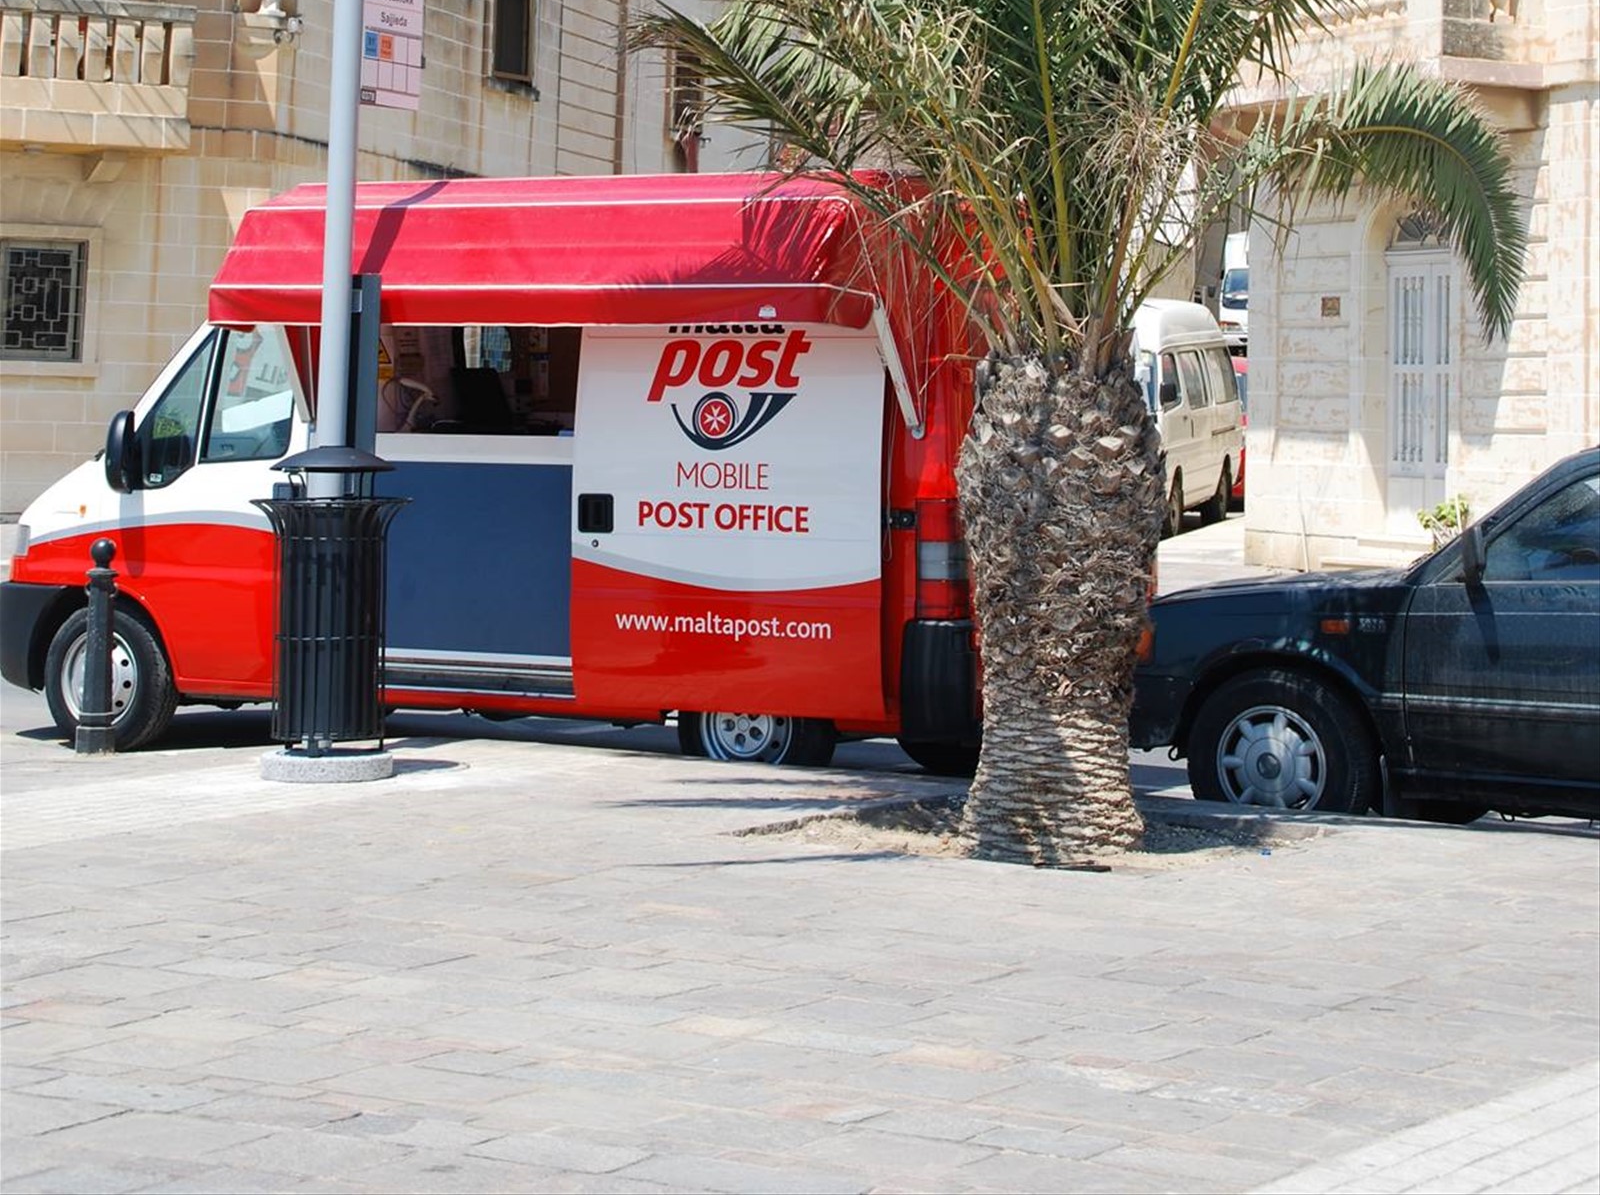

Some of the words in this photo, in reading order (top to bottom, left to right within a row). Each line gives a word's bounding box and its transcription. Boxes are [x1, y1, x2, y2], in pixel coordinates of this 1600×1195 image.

[647, 330, 811, 402] post
[677, 462, 769, 490] MOBILE
[638, 501, 711, 529] POST
[714, 504, 810, 533] OFFICE
[615, 611, 832, 642] www.maltapost.com
